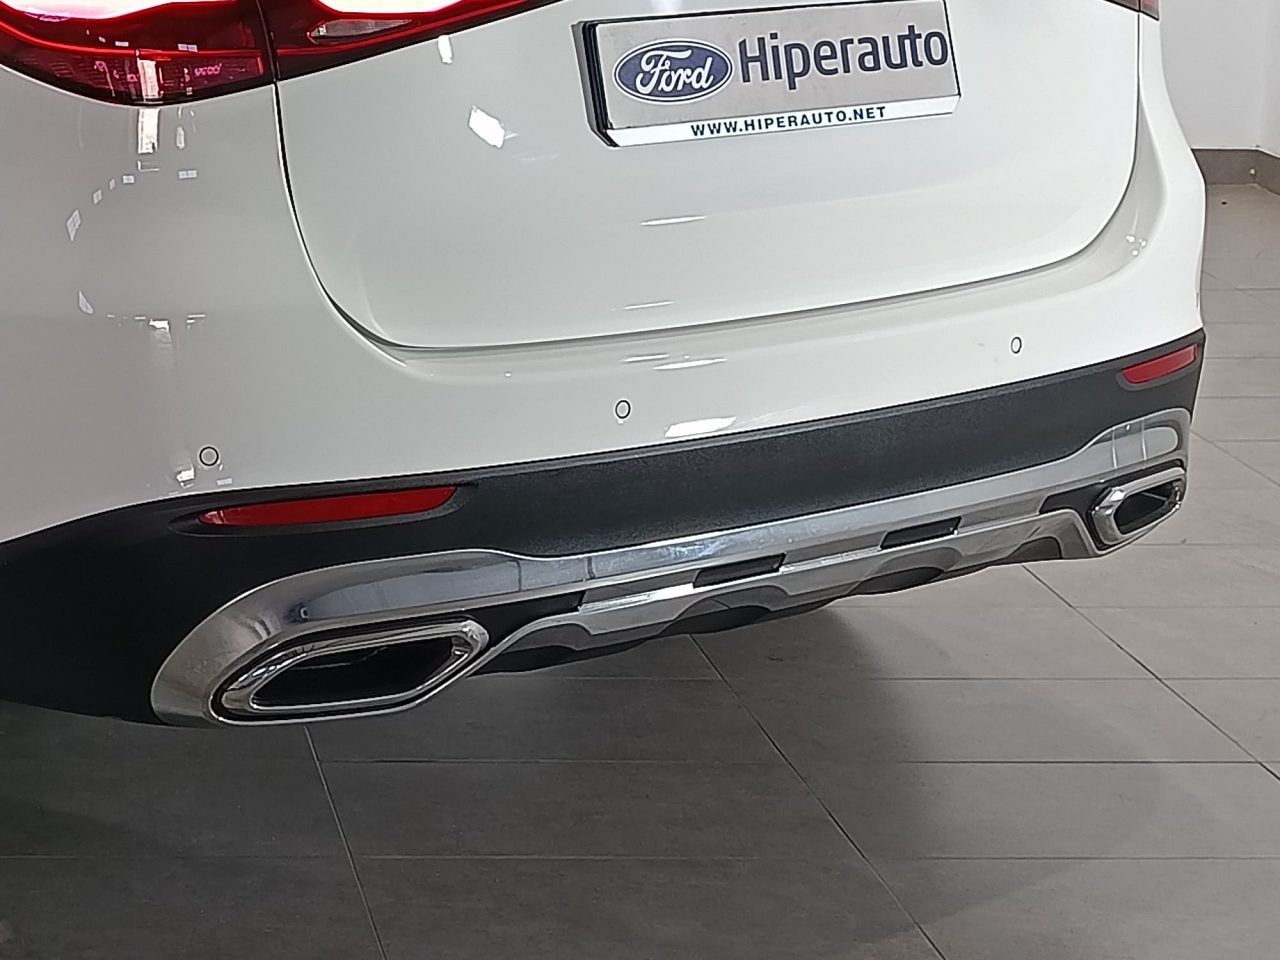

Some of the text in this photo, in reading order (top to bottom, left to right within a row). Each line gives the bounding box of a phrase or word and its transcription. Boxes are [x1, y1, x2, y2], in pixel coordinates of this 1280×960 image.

[634, 24, 949, 95] Ford Hiperauto
[690, 105, 888, 138] WWW.HIPERAUTO.NET
